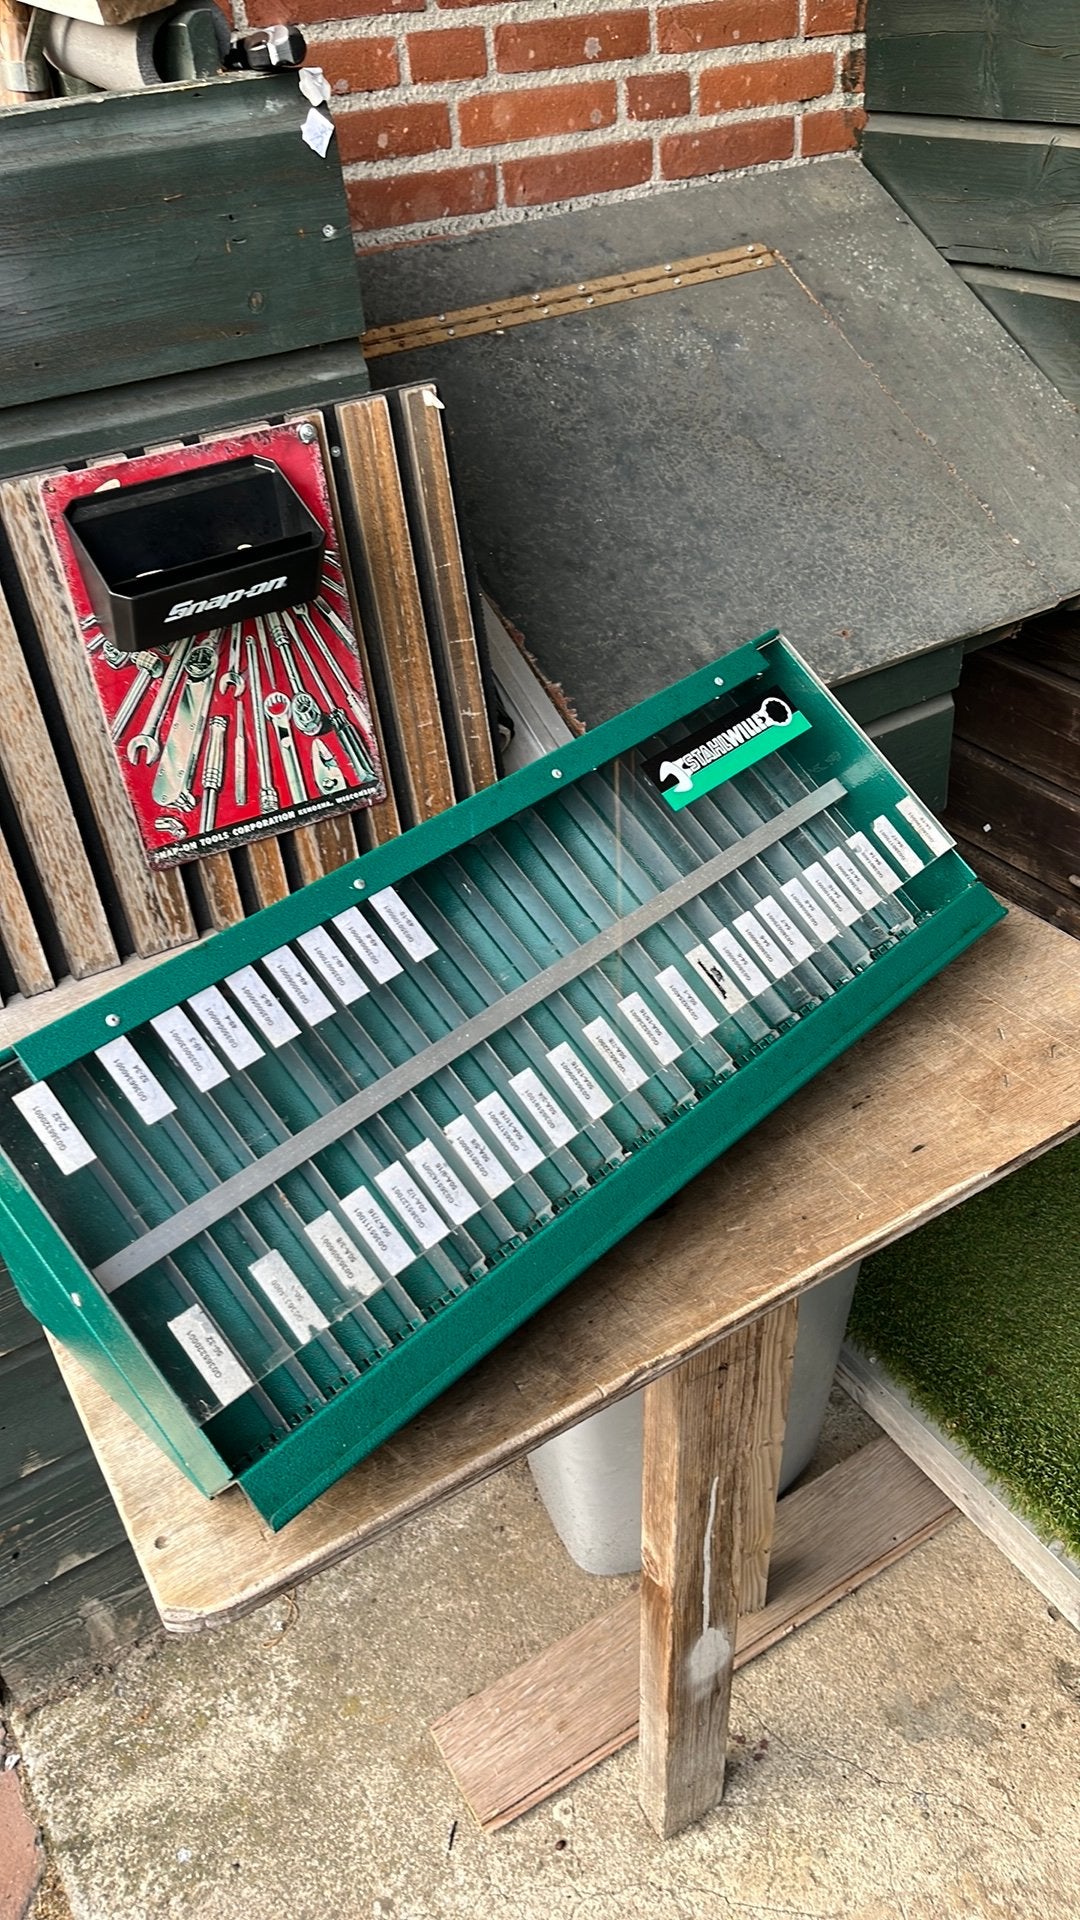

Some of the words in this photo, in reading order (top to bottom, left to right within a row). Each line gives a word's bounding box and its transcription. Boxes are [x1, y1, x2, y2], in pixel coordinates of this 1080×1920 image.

[163, 576, 287, 623] Snap-on
[682, 713, 767, 772] STAHLWILLE
[155, 841, 198, 861] SNAP-ON
[200, 831, 229, 846] TOOLS
[232, 811, 296, 836] CORPORATION
[335, 787, 377, 804] WISCONSIN
[400, 911, 414, 927] 49-10
[332, 955, 344, 968] 49-7
[295, 972, 308, 985] 49-6
[260, 993, 273, 1007] 49-5
[224, 1015, 237, 1029] 49-4
[189, 1037, 203, 1051] 49-3
[132, 1064, 149, 1083] 52-34
[52, 1112, 69, 1132] 52-32
[499, 1110, 523, 1140] 50A-11/16
[406, 1188, 427, 1213] 50A-1/2
[367, 1208, 391, 1237] 50A-7/16
